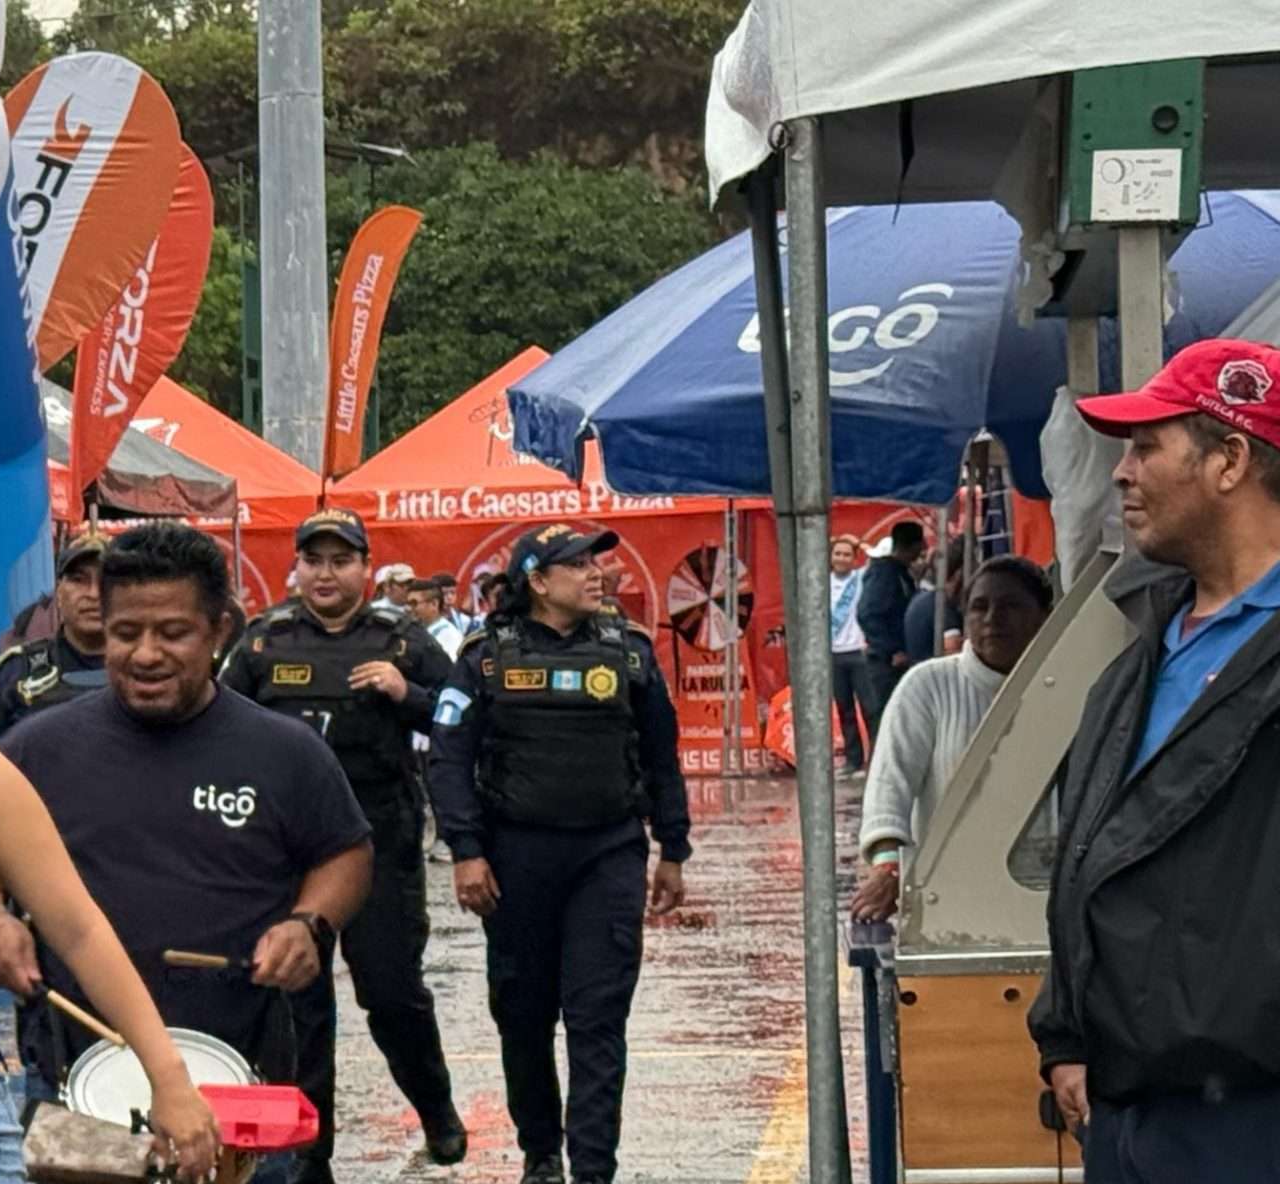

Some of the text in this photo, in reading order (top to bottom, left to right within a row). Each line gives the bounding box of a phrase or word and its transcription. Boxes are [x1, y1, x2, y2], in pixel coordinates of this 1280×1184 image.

[335, 253, 385, 433] Little Caesars Pizza
[373, 488, 459, 522] Little
[460, 485, 583, 520] Caesars
